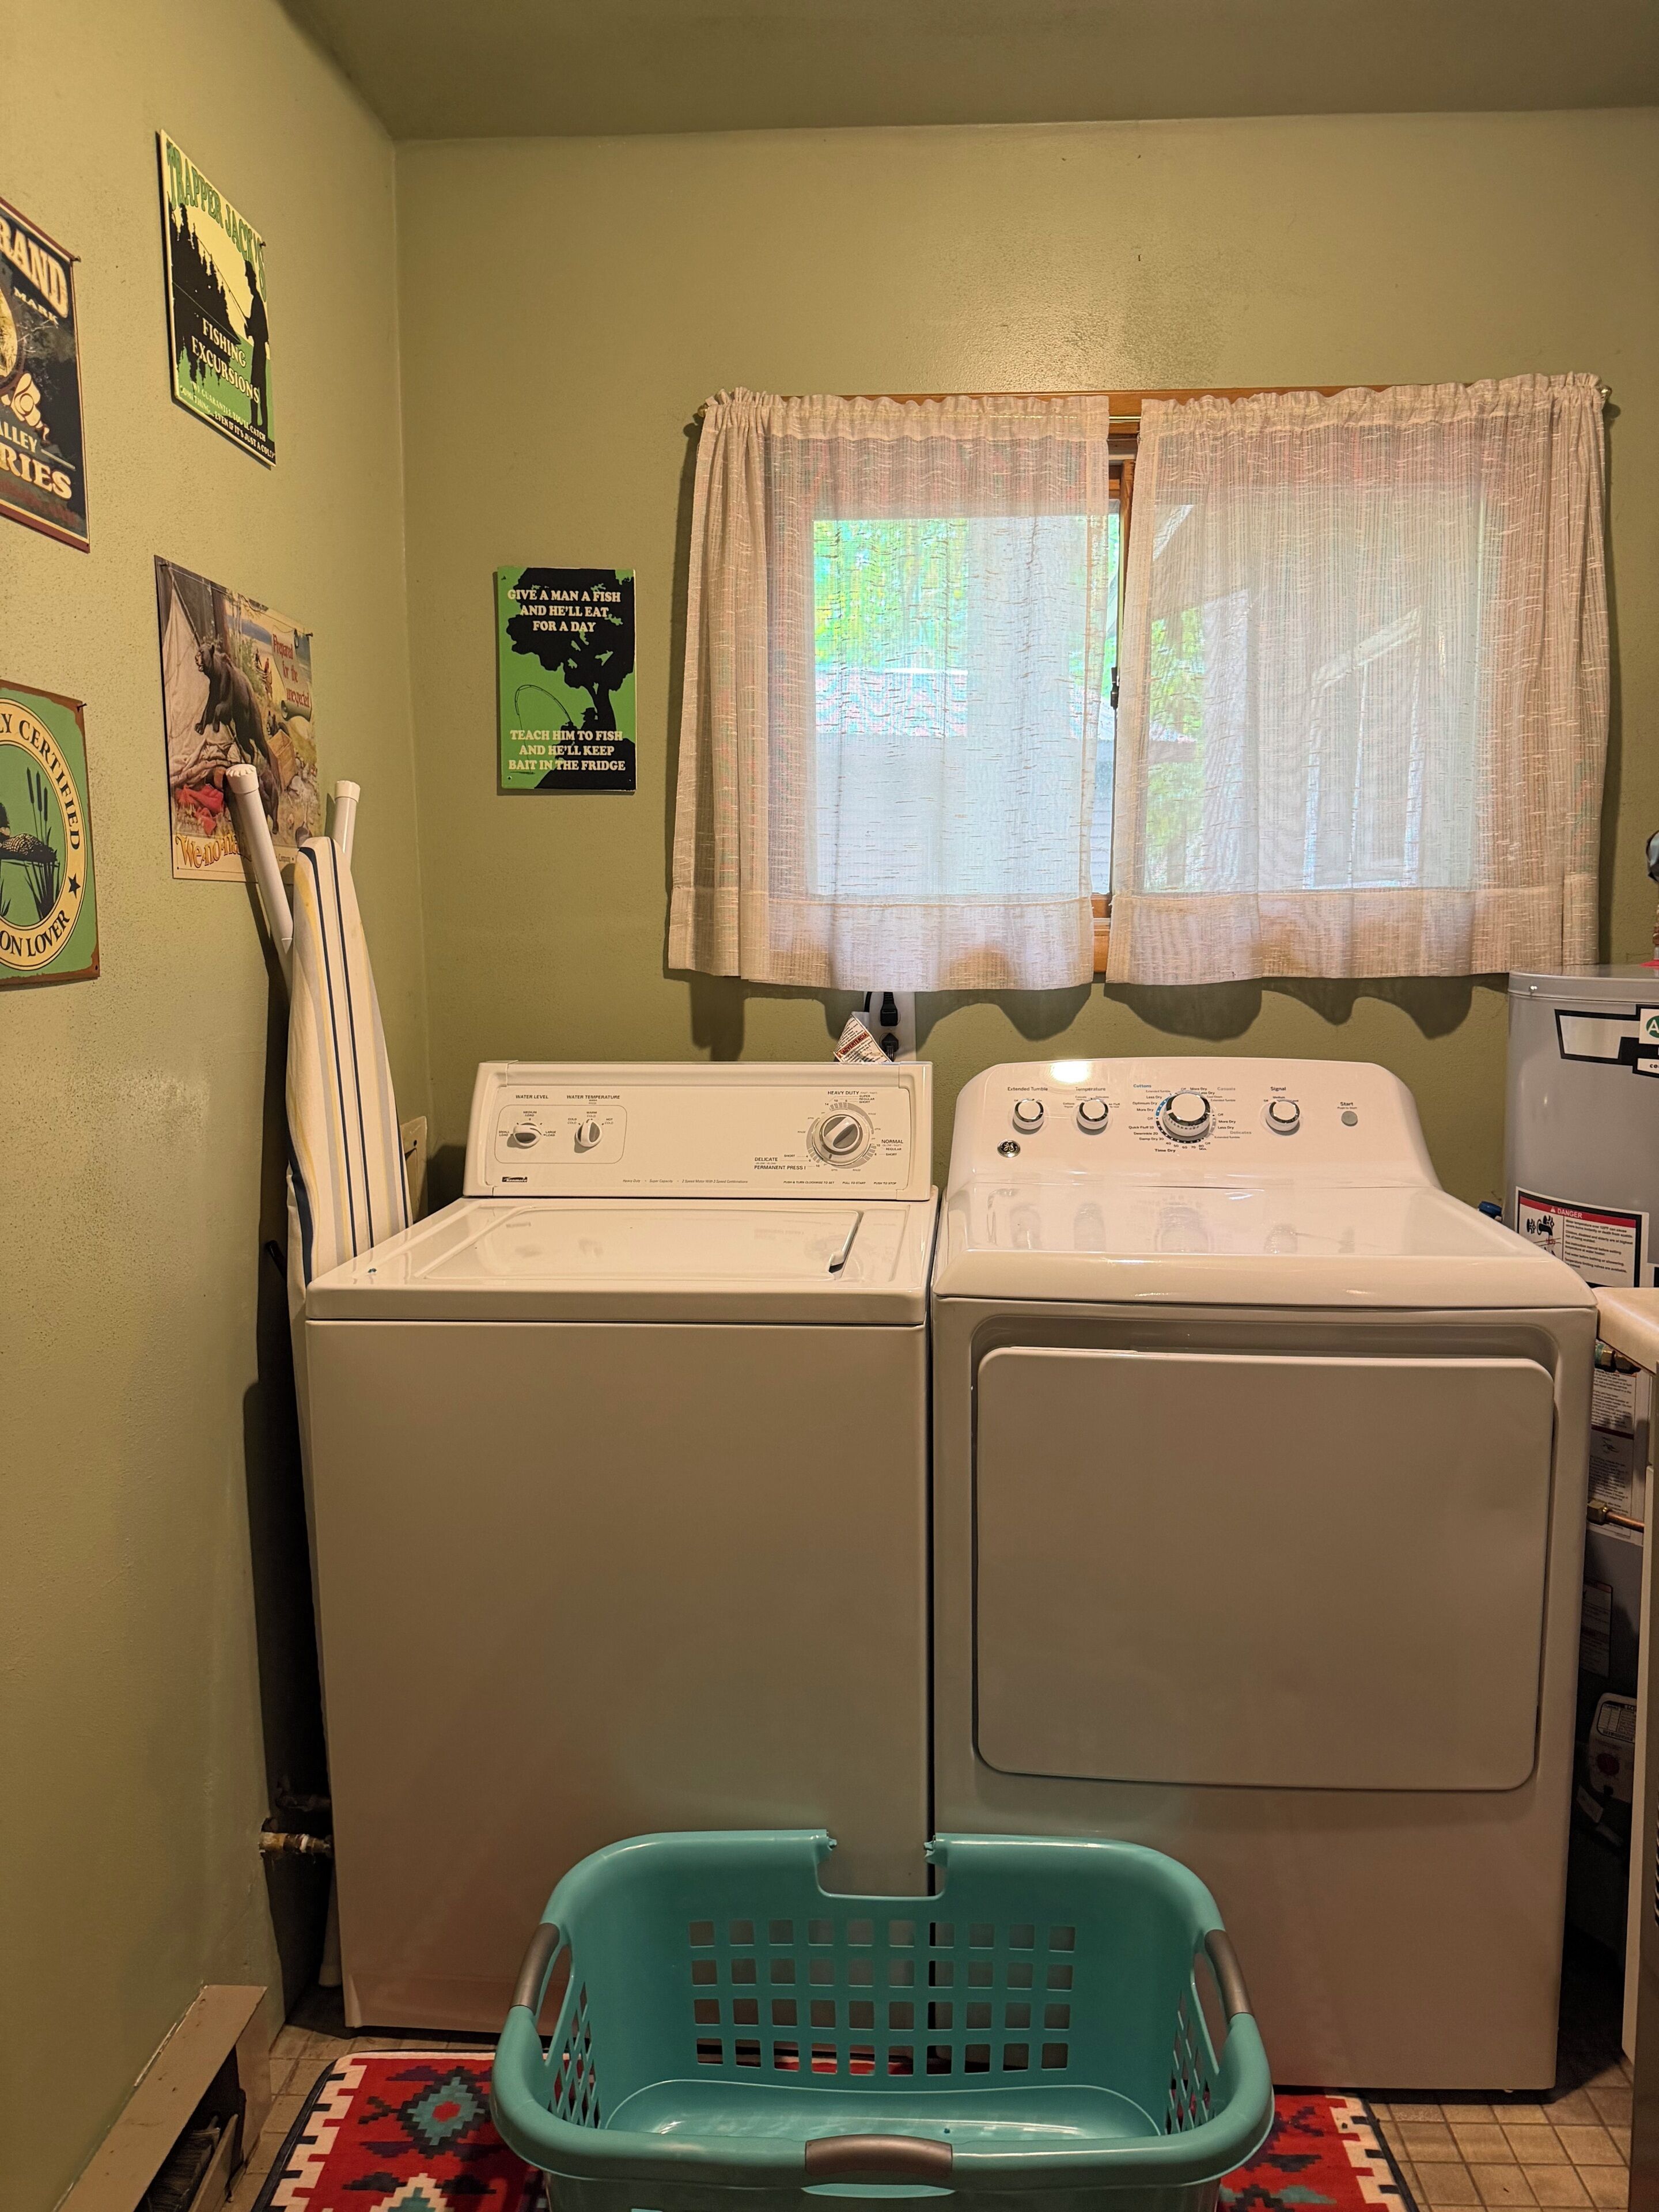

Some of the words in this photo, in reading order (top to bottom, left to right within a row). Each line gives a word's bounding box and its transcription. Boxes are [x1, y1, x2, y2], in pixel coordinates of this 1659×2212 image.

[166, 138, 224, 229] TRAPPER
[225, 204, 266, 302] JACK'S
[14, 286, 59, 324] MARK
[202, 317, 247, 368] FISHING
[191, 335, 260, 404] EXCURSIONS
[215, 411, 229, 428] EVEN
[229, 421, 234, 431] IF
[234, 425, 244, 438] IT'S
[244, 433, 256, 447] JUST
[257, 441, 261, 450] A
[249, 425, 266, 442] CATCH
[507, 589, 537, 600] GIVE
[539, 590, 548, 600] A
[551, 590, 578, 601] MAN
[581, 591, 590, 601] A
[593, 592, 621, 603] FISH
[520, 605, 547, 616] AND
[549, 606, 583, 616] HE'LL
[585, 607, 609, 618] EAT
[533, 621, 556, 631] FOR
[559, 622, 569, 631] A
[571, 622, 596, 632] DAY
[272, 634, 294, 660] Prepared
[286, 688, 310, 707] unexpected
[510, 730, 550, 740] TEACH
[552, 730, 575, 740] HIM
[577, 730, 593, 740] TO
[596, 730, 623, 741] FISH
[519, 745, 546, 755] AND
[548, 745, 581, 756] HE'LL
[584, 746, 615, 756] KEEP
[509, 760, 537, 770] BAIT
[540, 760, 552, 770] IN
[555, 760, 579, 770] THE
[581, 760, 626, 771] FRIDGE
[19, 719, 81, 850] CERTIFIED
[26, 910, 70, 957] LOVER
[1557, 1208, 1583, 1219] DANGER
